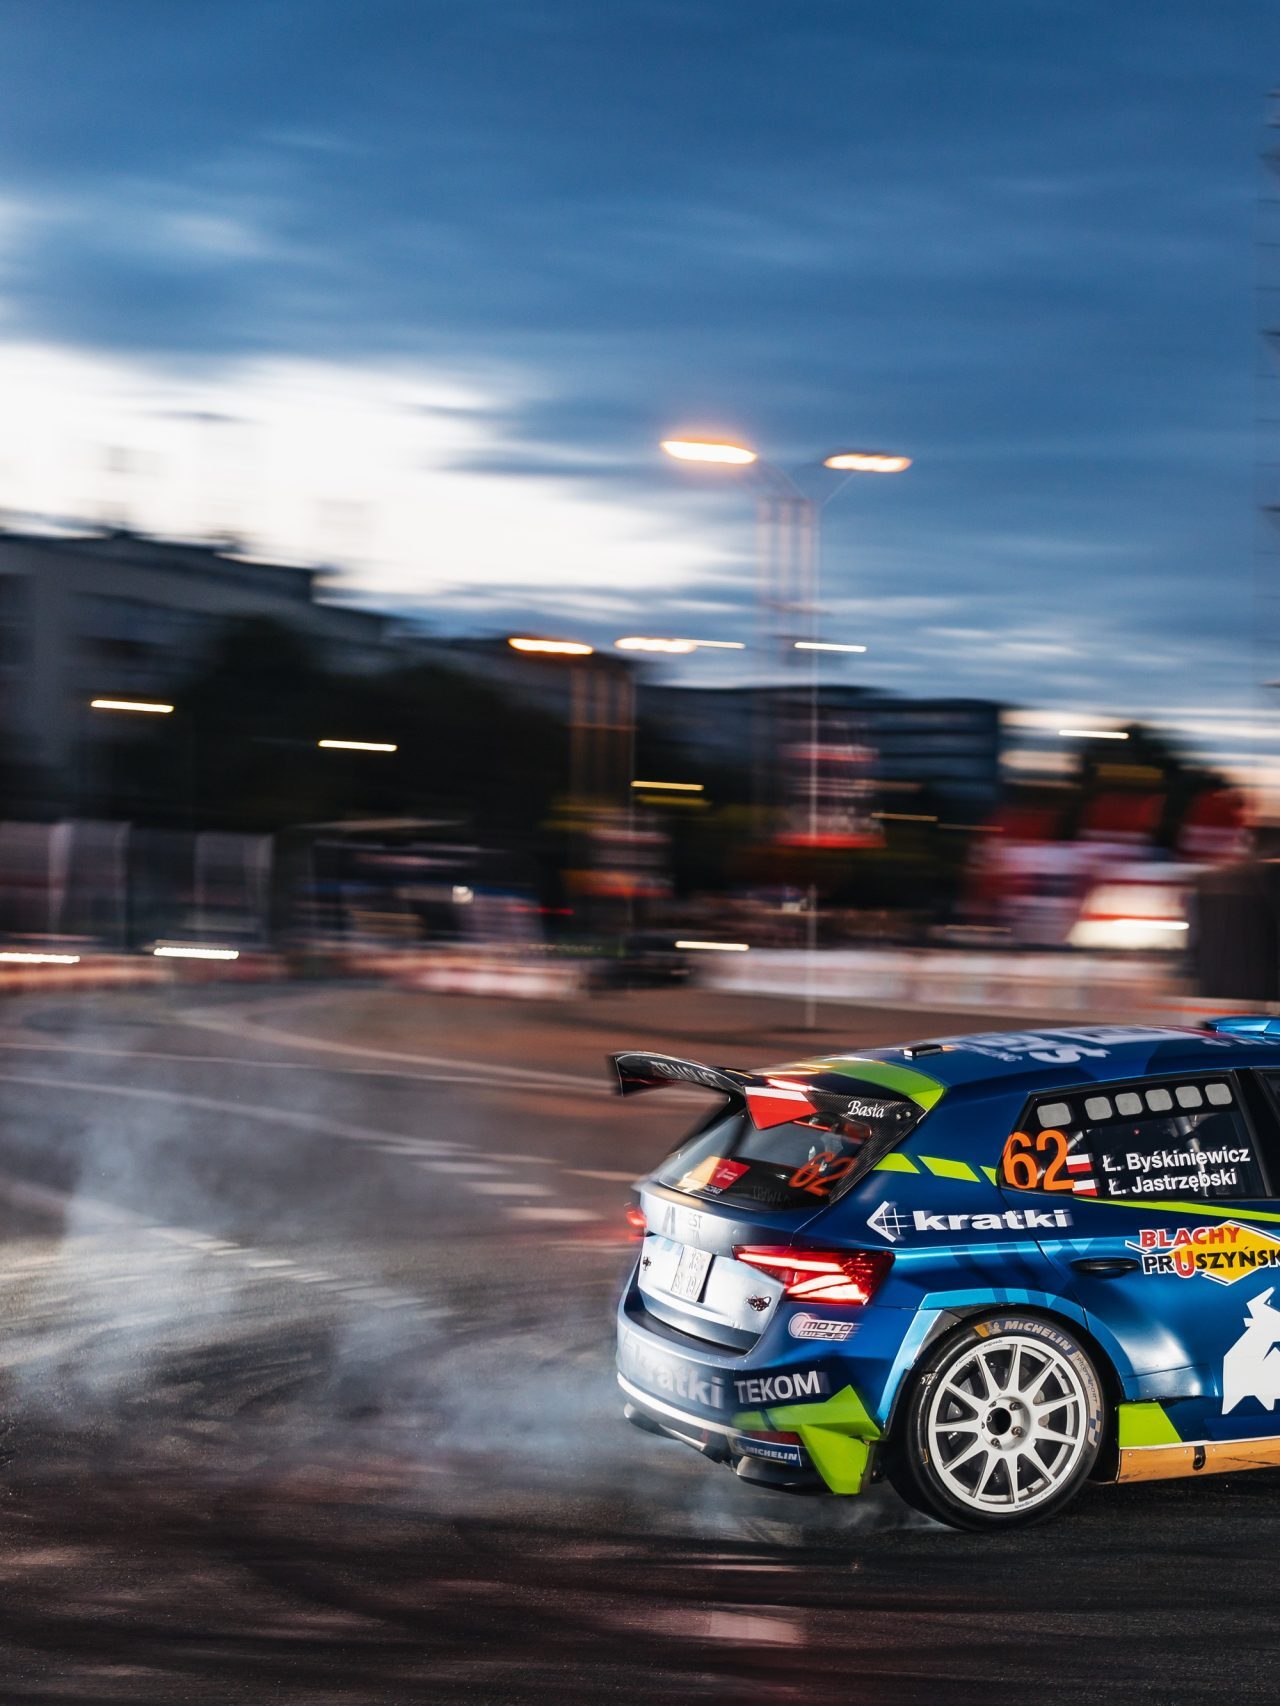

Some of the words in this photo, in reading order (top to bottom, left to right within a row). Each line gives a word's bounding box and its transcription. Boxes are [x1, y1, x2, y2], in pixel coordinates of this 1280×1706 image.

[1003, 1129, 1075, 1191] 62
[1125, 1145, 1251, 1173] Byśkiniewicz
[787, 1151, 858, 1197] 62
[1131, 1168, 1238, 1194] Jastrzębski
[912, 1208, 1070, 1231] kratki
[1139, 1226, 1241, 1248] BLACHY
[803, 1321, 852, 1332] MOTO
[1003, 1320, 1072, 1351] MICHELIN
[733, 1370, 821, 1404] TEKOM
[745, 1446, 798, 1461] MICHELIN
